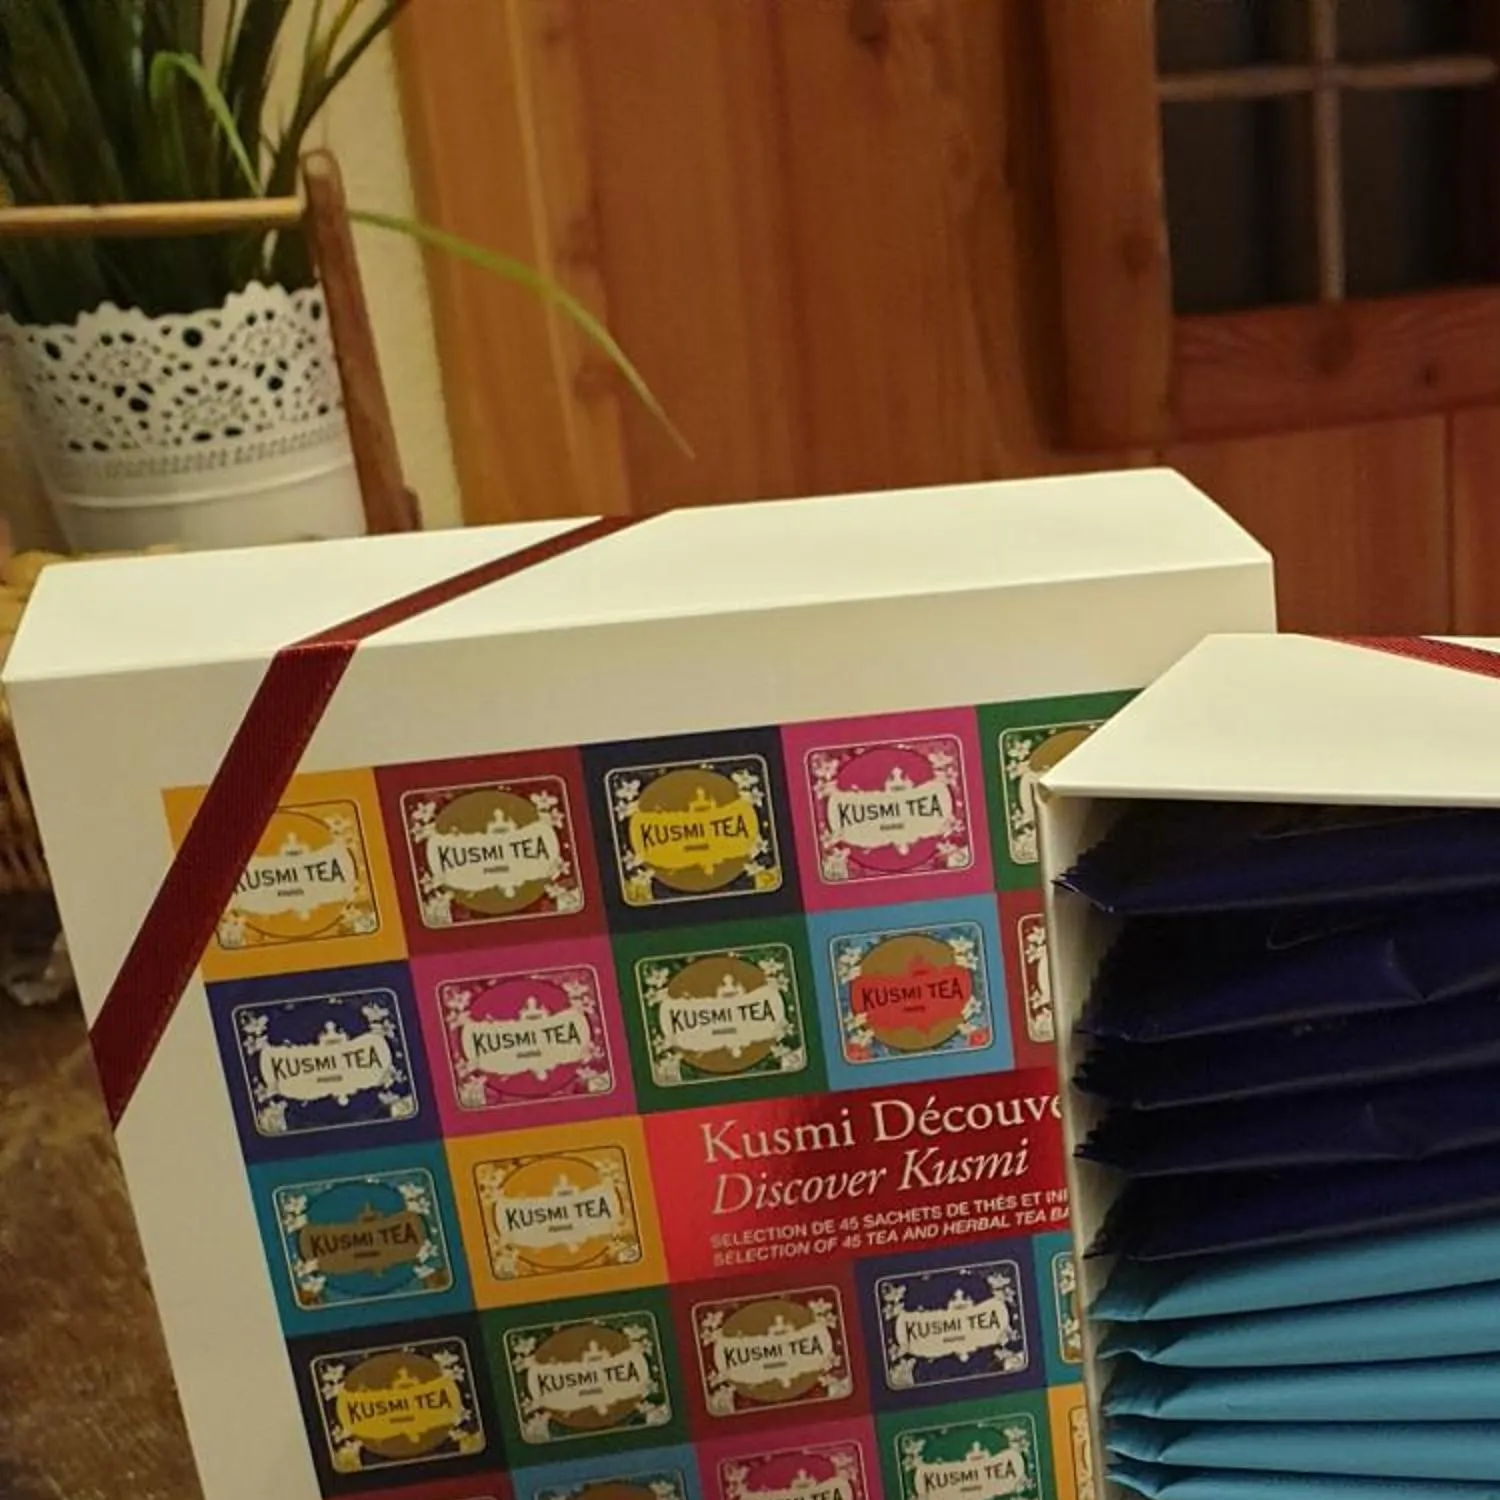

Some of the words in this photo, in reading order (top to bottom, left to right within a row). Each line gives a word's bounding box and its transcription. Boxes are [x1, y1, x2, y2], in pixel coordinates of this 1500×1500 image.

[837, 799, 901, 824] KUSMI
[905, 794, 943, 818] TEA
[640, 824, 706, 849] KUSMI
[711, 815, 748, 838] TEA
[437, 843, 504, 869] KUSMI
[509, 835, 550, 859] TEA
[304, 858, 345, 883] TEA
[861, 985, 923, 1009] KUSMI
[928, 976, 965, 1000] TEA
[669, 1007, 733, 1030] KUSMI
[738, 1000, 776, 1024] TEA
[472, 1032, 538, 1056] KUSMI
[541, 1021, 581, 1045] TEA
[270, 1055, 338, 1081] KUSMI
[343, 1045, 384, 1069] TEA
[700, 1107, 856, 1164] Kusmi
[711, 1165, 887, 1216] Discover
[896, 1138, 1029, 1191] Kusmi
[504, 1207, 570, 1232] KUSMI
[573, 1198, 612, 1223] TEA
[811, 1219, 836, 1235] DE
[839, 1216, 860, 1231] 45
[863, 1204, 942, 1229] SACHETS
[946, 1201, 970, 1217] DE
[1020, 1191, 1041, 1208] ET
[308, 1231, 374, 1257] KUSMI
[378, 1222, 419, 1247] TEA
[813, 1237, 838, 1254] OF
[842, 1234, 862, 1249] 45
[866, 1228, 898, 1246] TEA
[902, 1223, 939, 1242] AND
[943, 1216, 1011, 1236] HERBAL
[1014, 1209, 1046, 1226] TEA
[905, 1319, 963, 1342] KUSMI
[966, 1311, 1000, 1333] TEA
[723, 1346, 784, 1370] KUSMI
[788, 1335, 824, 1357] TEA
[537, 1370, 598, 1394] KUSMI
[602, 1363, 640, 1386] TEA
[347, 1400, 409, 1425] KUSMI
[415, 1390, 452, 1413] TEA
[923, 1469, 979, 1491] KUSMI
[984, 1461, 1017, 1482] TEA
